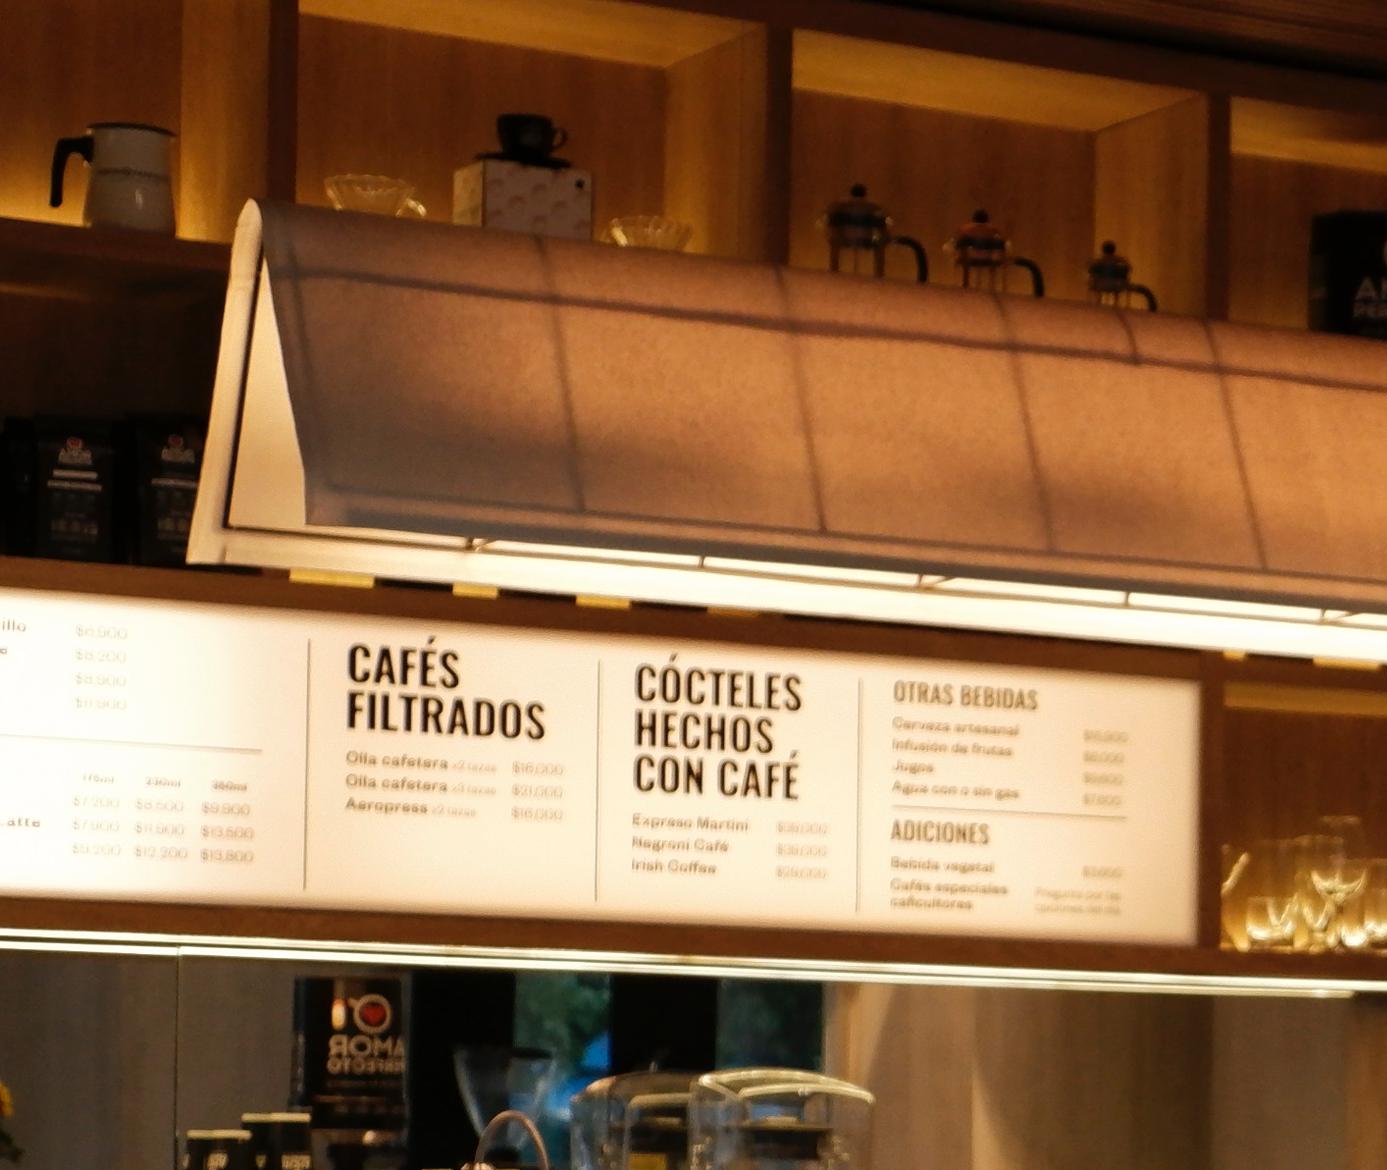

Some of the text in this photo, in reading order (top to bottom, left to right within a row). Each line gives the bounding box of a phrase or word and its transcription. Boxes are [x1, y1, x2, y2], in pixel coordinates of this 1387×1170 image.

[347, 636, 460, 690] CAFÉS
[634, 654, 802, 712] CÓCTELES
[893, 680, 1039, 711] OTRAS BEBIDAS
[346, 690, 546, 741] FILTRADOS
[633, 709, 774, 754] HECHOS
[892, 716, 1020, 737] Cerveza artesanal
[971, 742, 1014, 758] frutas
[381, 754, 449, 771] cafetera
[632, 750, 800, 801] CON CAFÉ
[381, 777, 448, 793] cafetera
[892, 780, 929, 796] Agua
[345, 797, 428, 815] Aeropress
[696, 816, 750, 833] Martini
[890, 819, 990, 845] ADICIONES
[631, 836, 690, 852] Negroni
[631, 859, 718, 875] Irish Coffee
[890, 856, 995, 875] Bebida vegetal
[934, 882, 1009, 897] especiales
